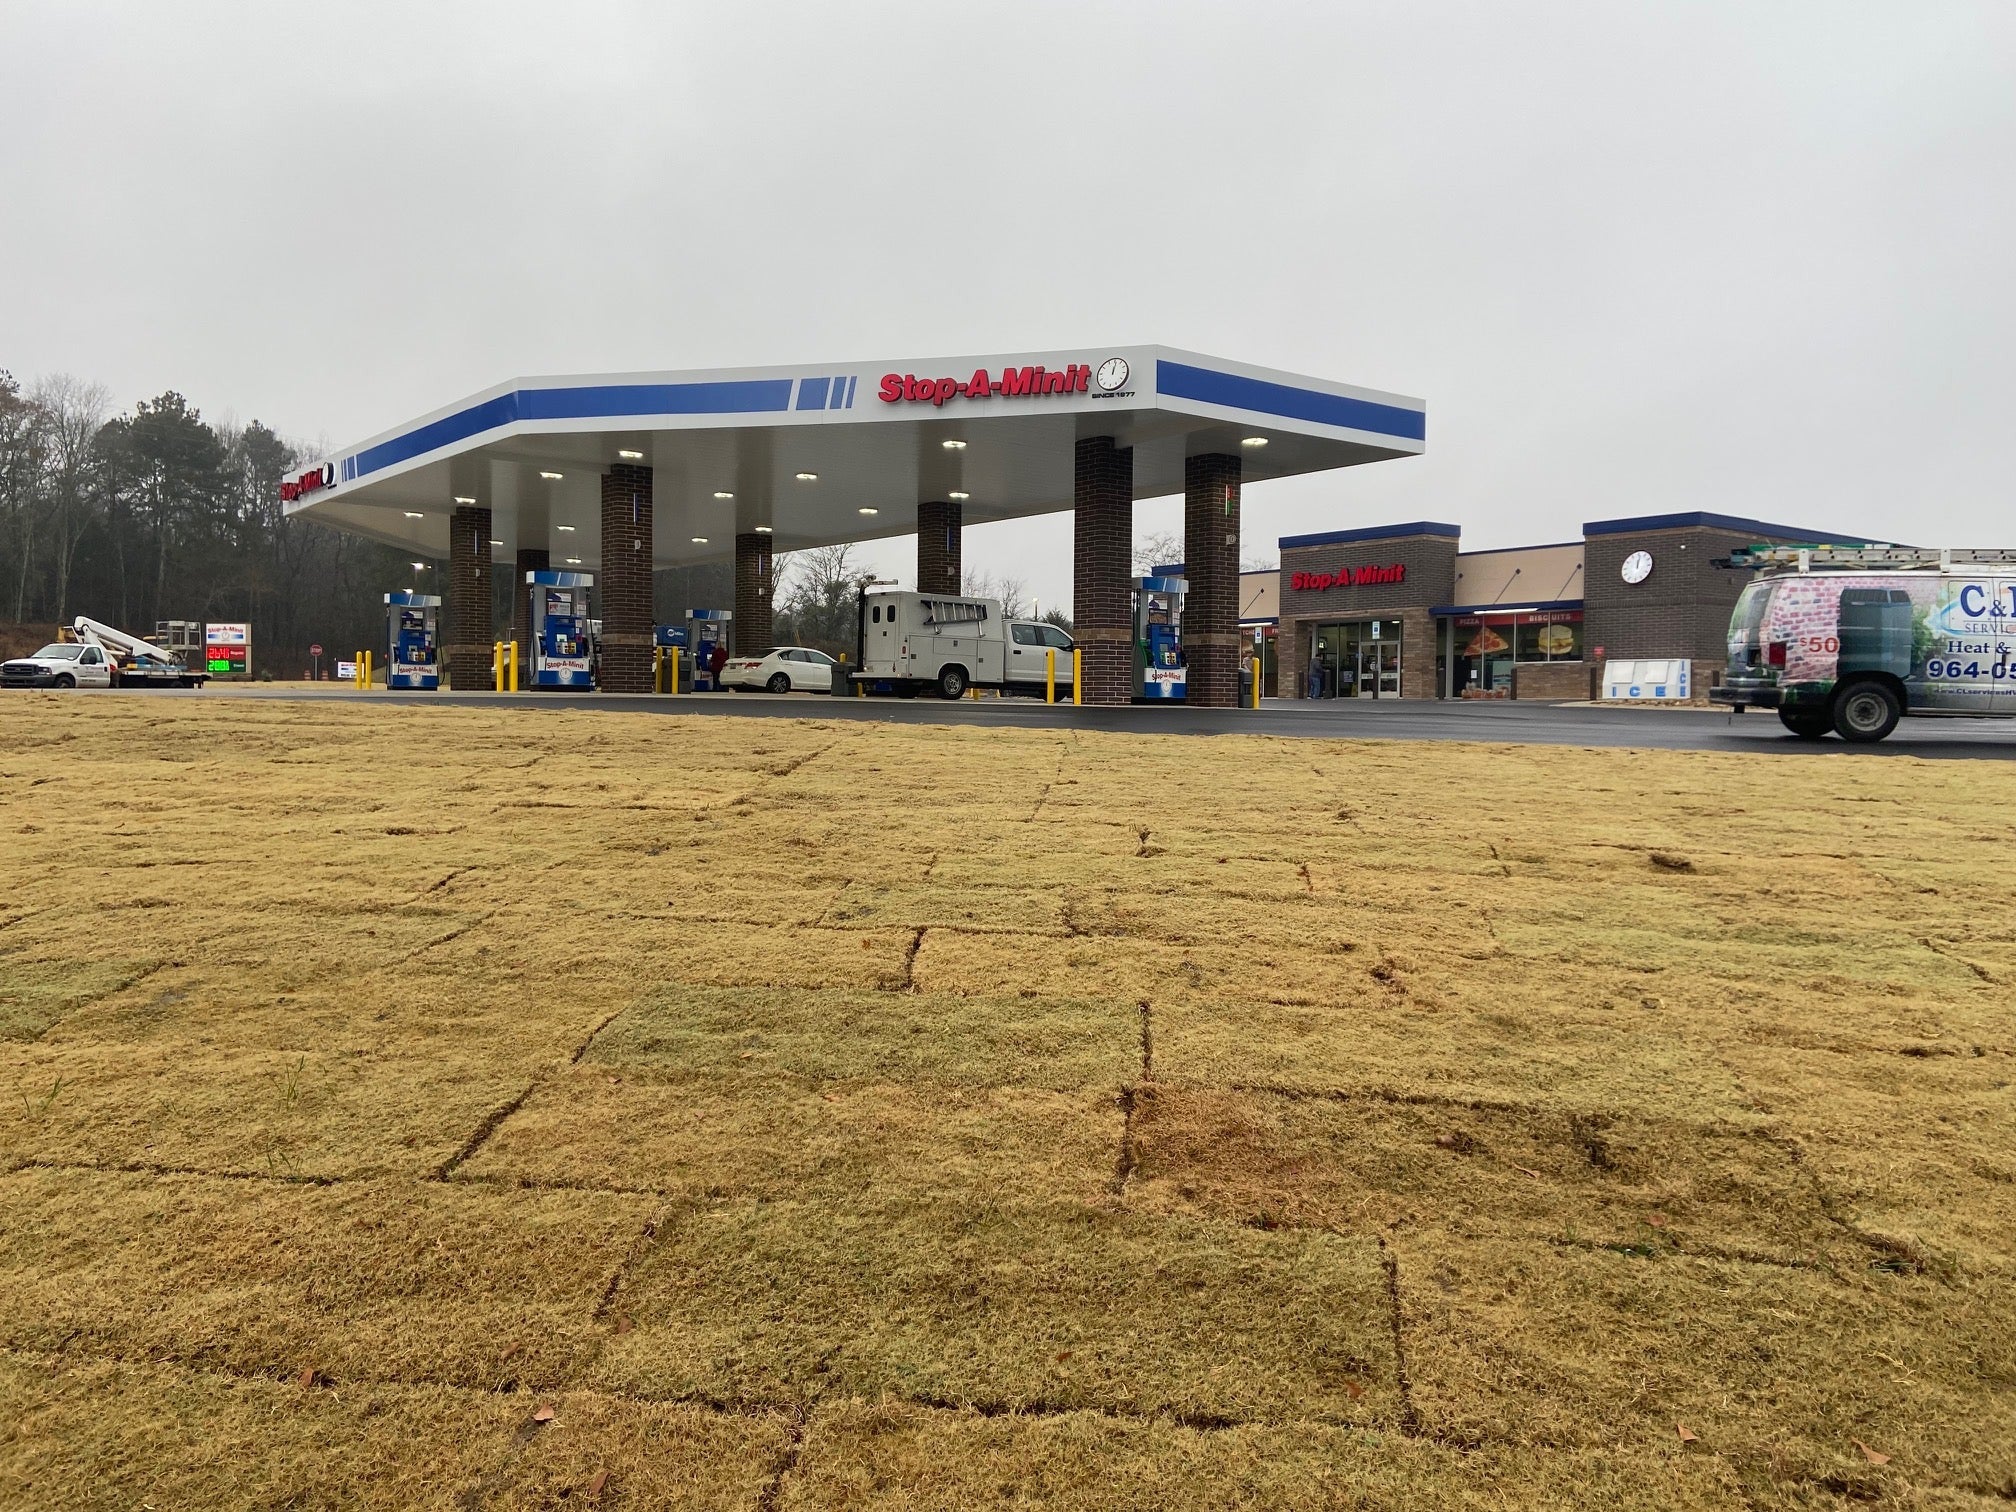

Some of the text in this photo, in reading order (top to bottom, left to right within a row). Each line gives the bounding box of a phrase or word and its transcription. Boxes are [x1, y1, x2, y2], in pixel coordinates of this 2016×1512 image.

[878, 364, 1093, 406] Stop-A-Minit
[1291, 563, 1405, 592] Stop-A-Minit
[1529, 614, 1571, 622] BISCUITS
[1800, 637, 1839, 653] $50
[1947, 640, 2011, 655] Heat &
[400, 666, 433, 674] Stop-A-Minit
[547, 660, 584, 669] Stop-A-Minit
[1612, 686, 1666, 697] ICE
